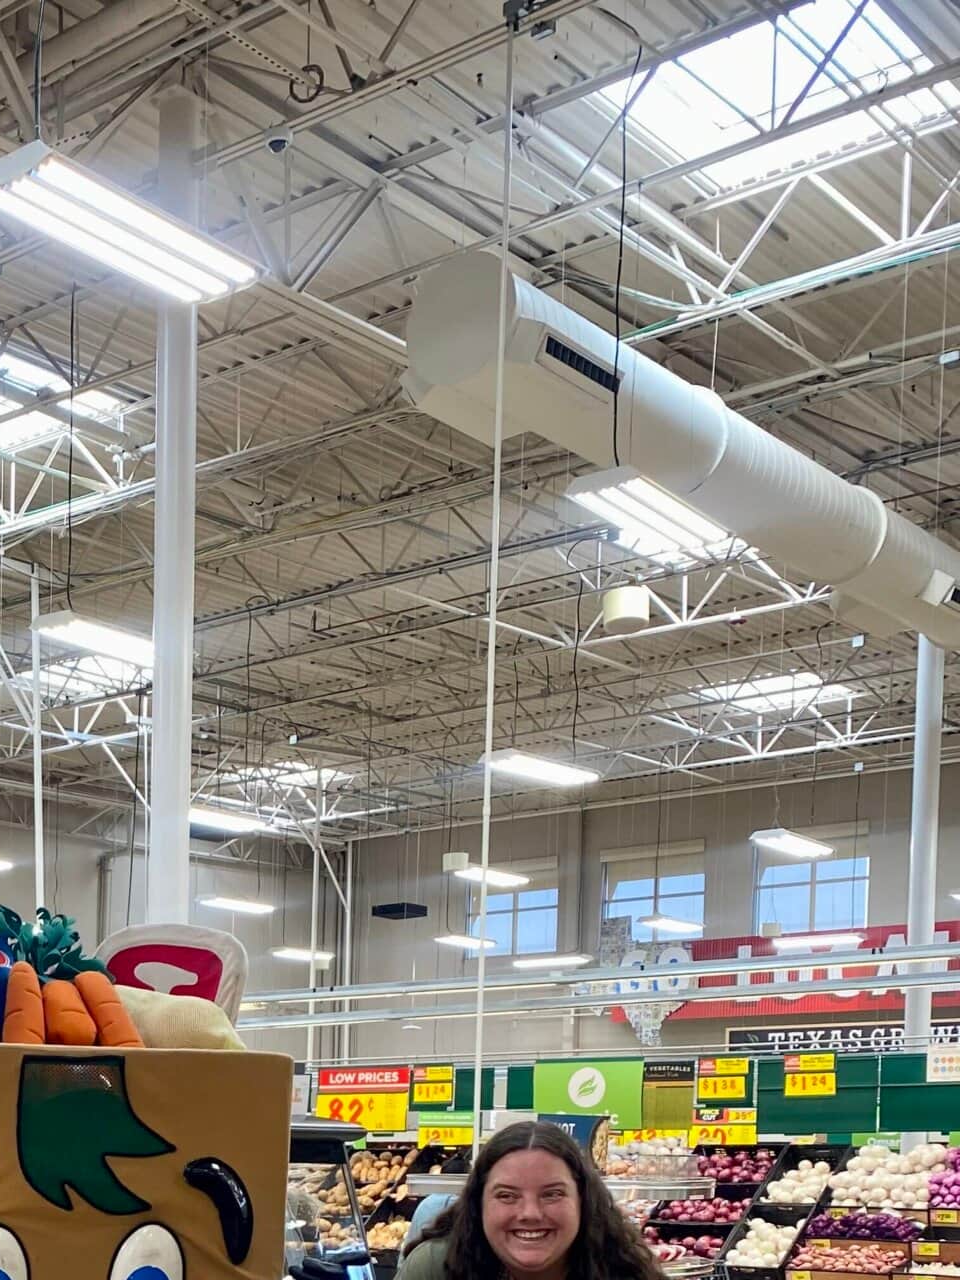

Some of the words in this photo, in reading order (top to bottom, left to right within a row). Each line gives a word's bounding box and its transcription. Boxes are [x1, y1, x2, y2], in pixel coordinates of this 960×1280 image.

[767, 1028, 864, 1053] TEXAS
[329, 1073, 355, 1085] LOW
[357, 1071, 399, 1083] PRICES
